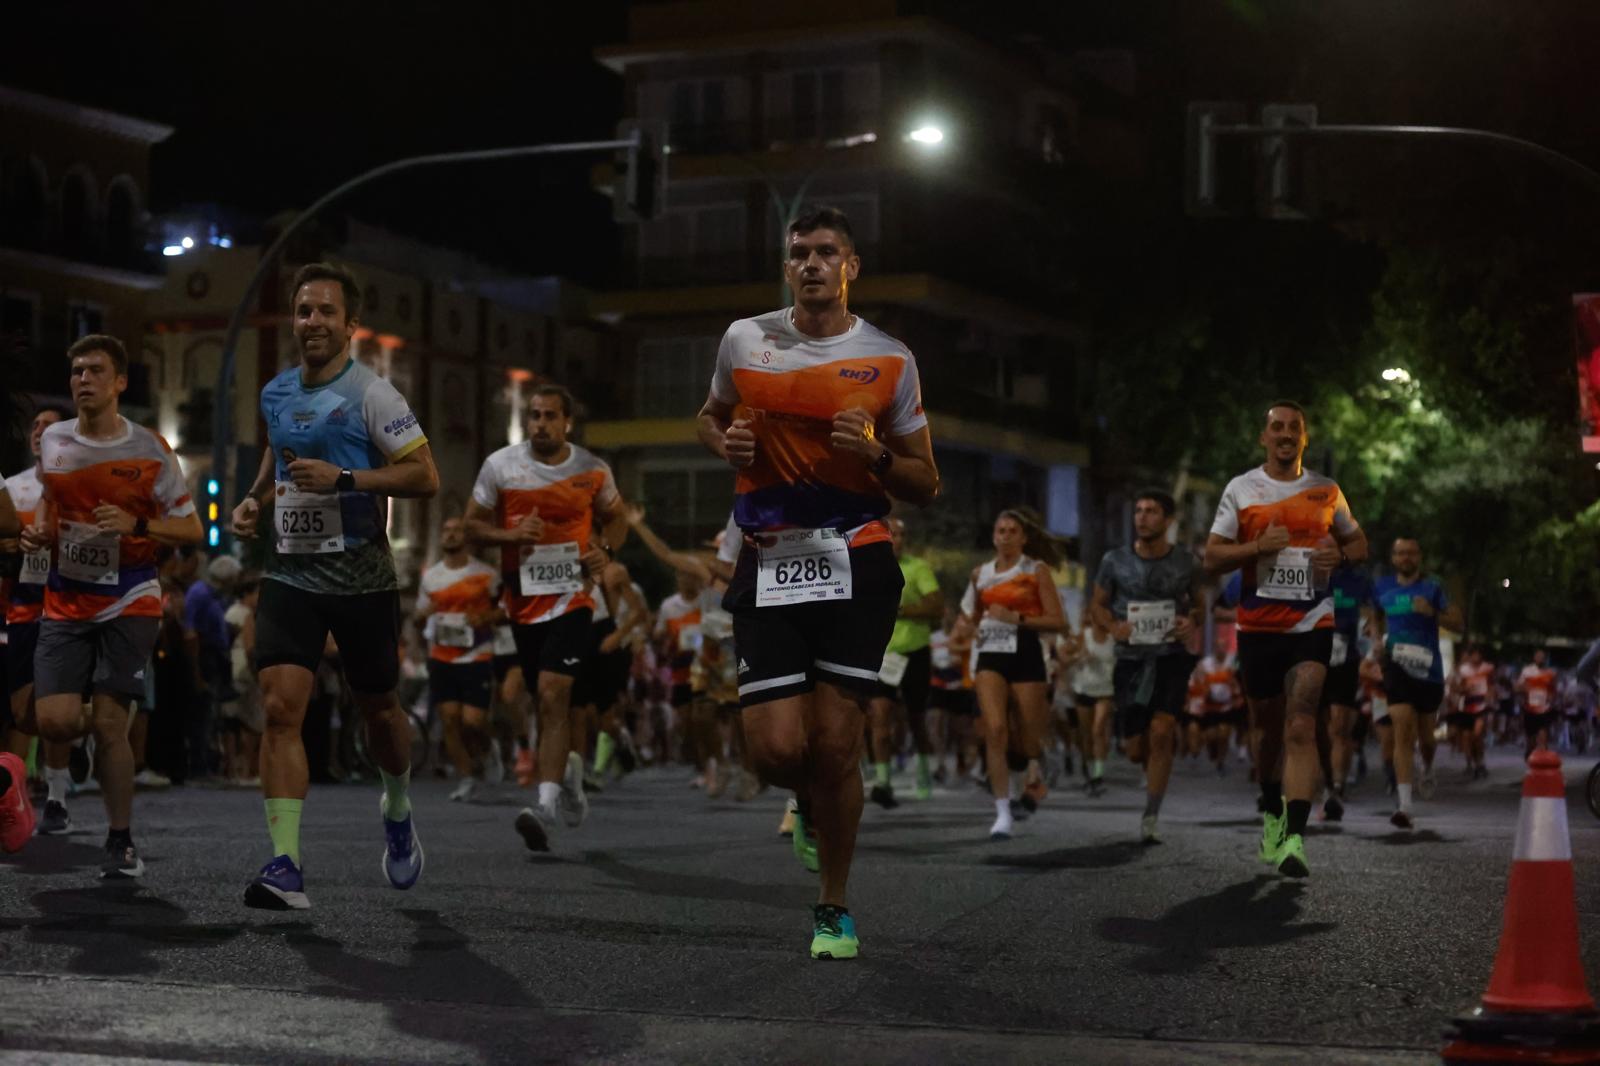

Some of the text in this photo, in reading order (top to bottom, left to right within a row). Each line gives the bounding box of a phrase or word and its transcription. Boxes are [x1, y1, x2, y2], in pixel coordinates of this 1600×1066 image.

[282, 510, 324, 533] 6235
[64, 543, 110, 567] 16623
[528, 563, 574, 581] 12308
[775, 557, 832, 585] 6286
[1267, 567, 1305, 586] 7390
